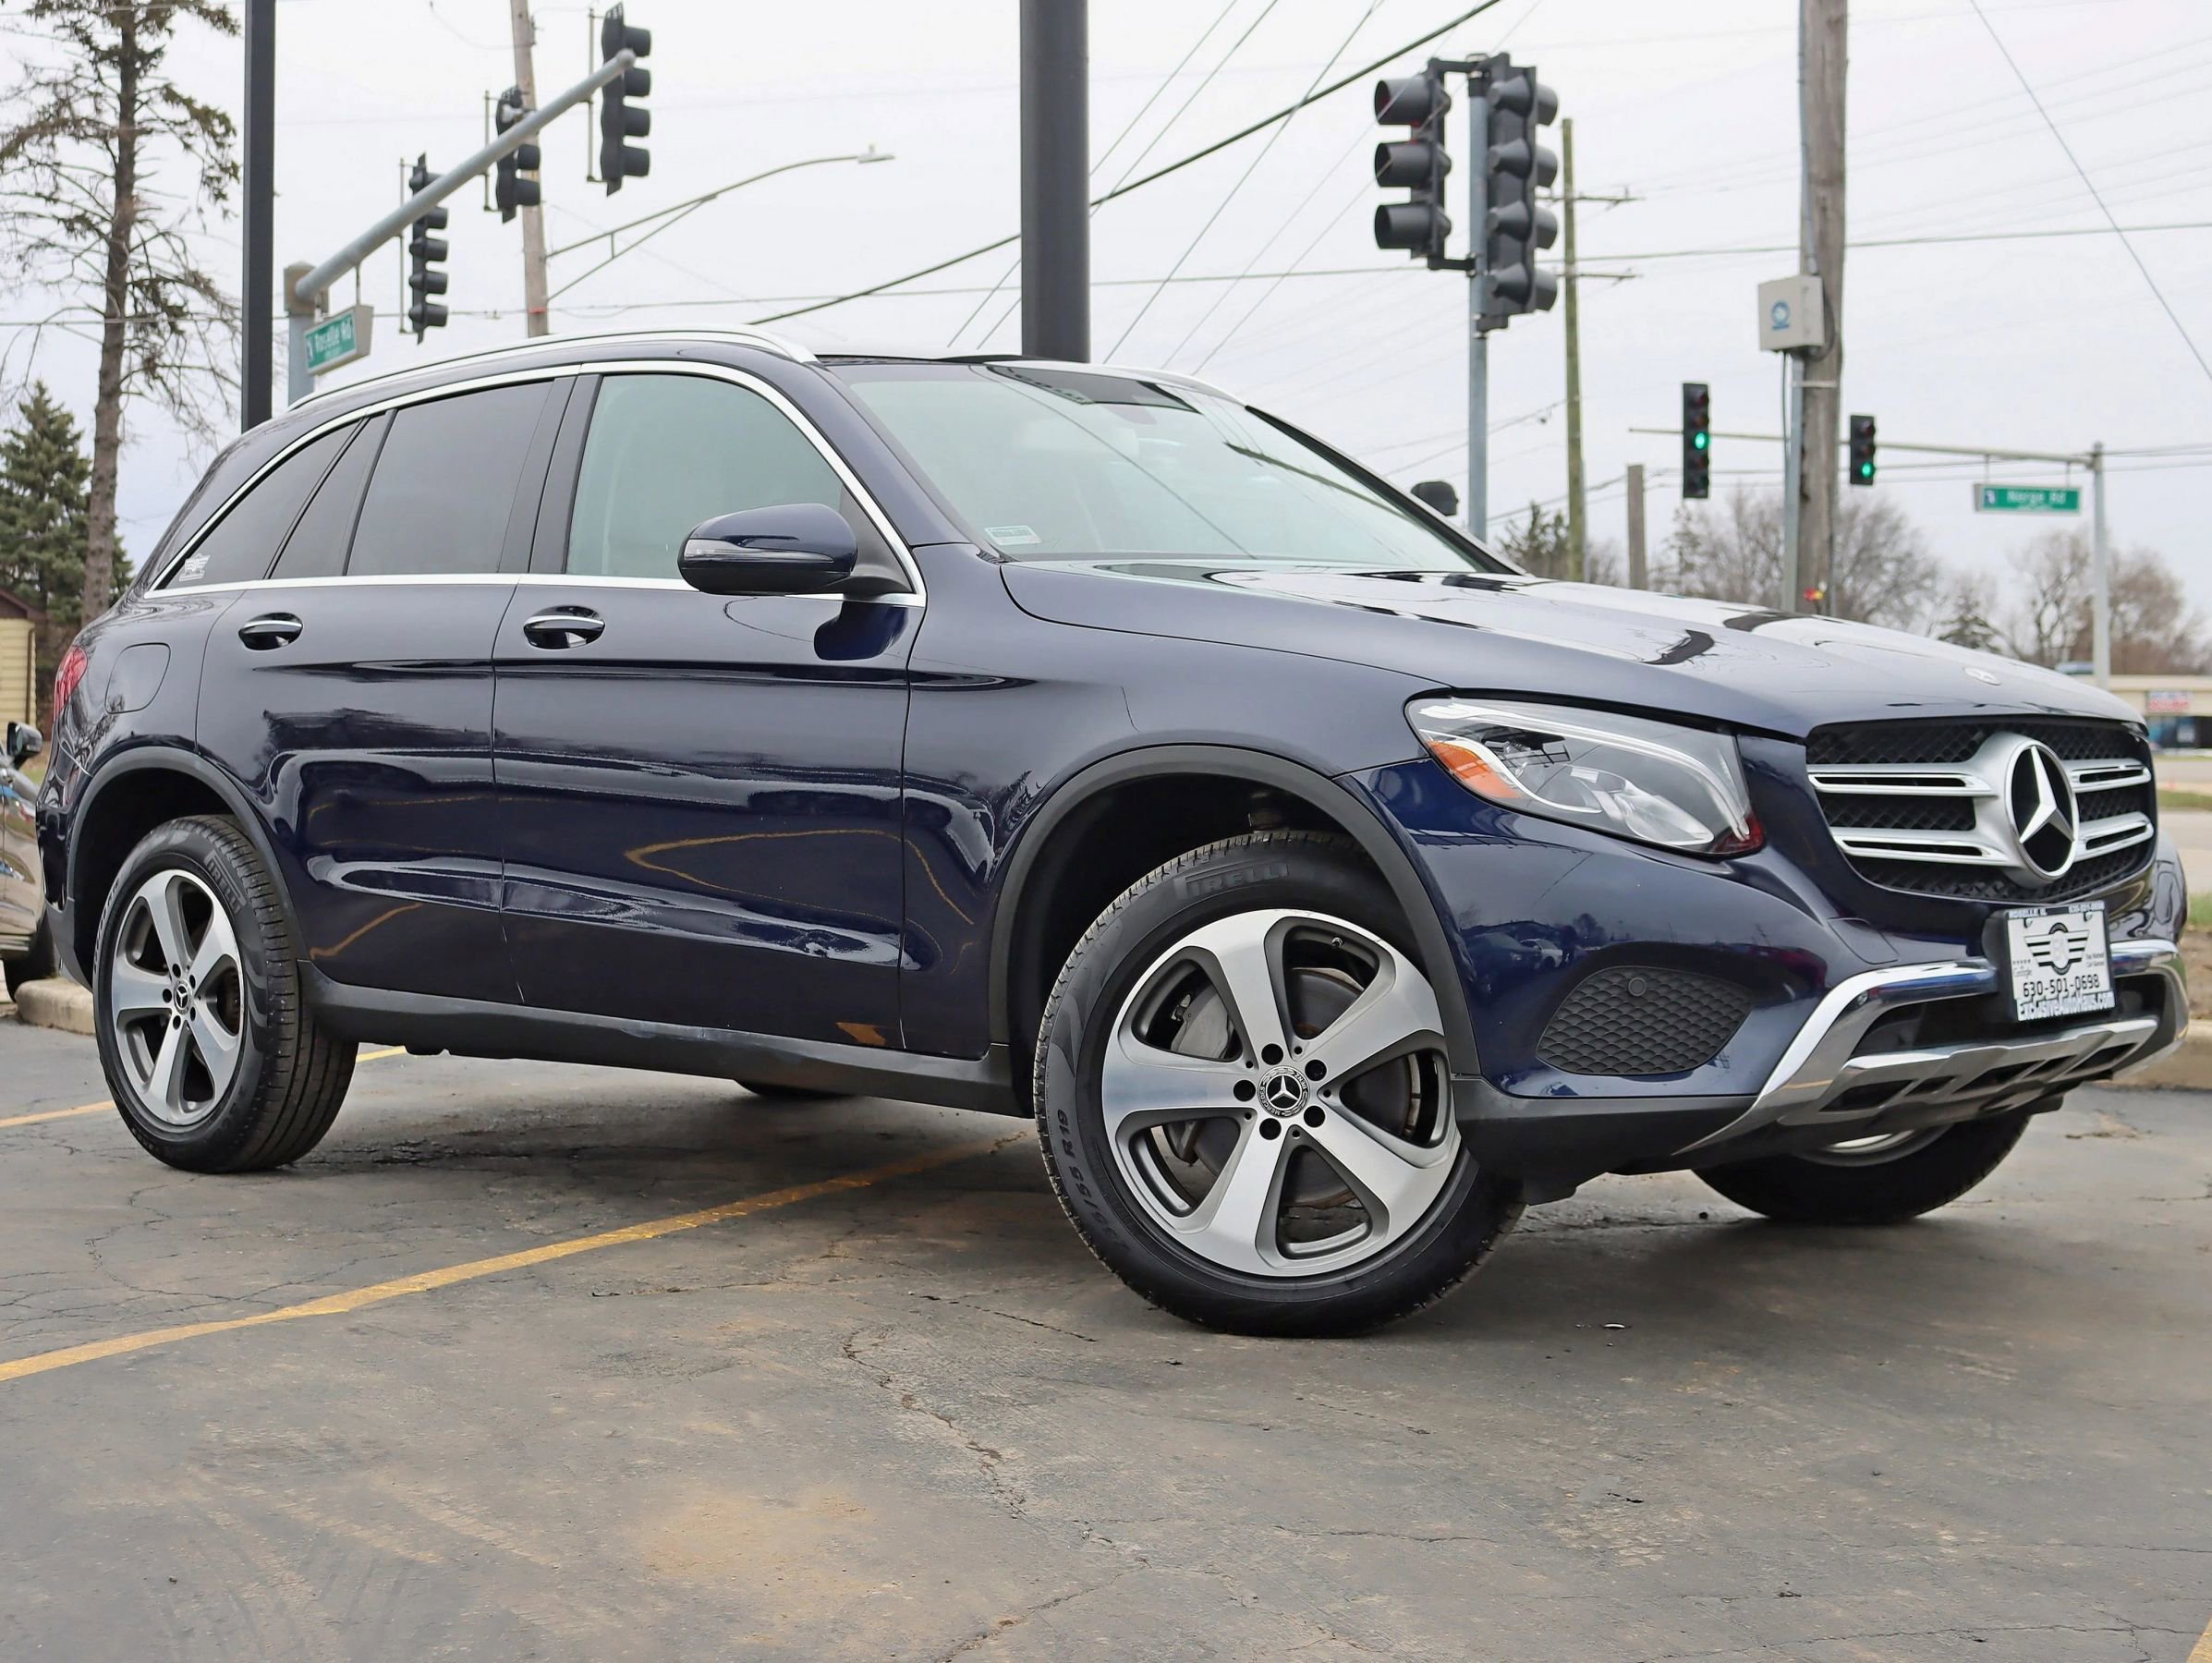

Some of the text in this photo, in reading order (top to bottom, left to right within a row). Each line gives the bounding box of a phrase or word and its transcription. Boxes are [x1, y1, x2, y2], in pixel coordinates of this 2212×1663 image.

[204, 849, 247, 915] PIRELLI
[1173, 857, 1290, 900] PIRELLI
[2024, 973, 2100, 998] 630-501-0698
[1259, 1086, 1282, 1116] MERCEDES
